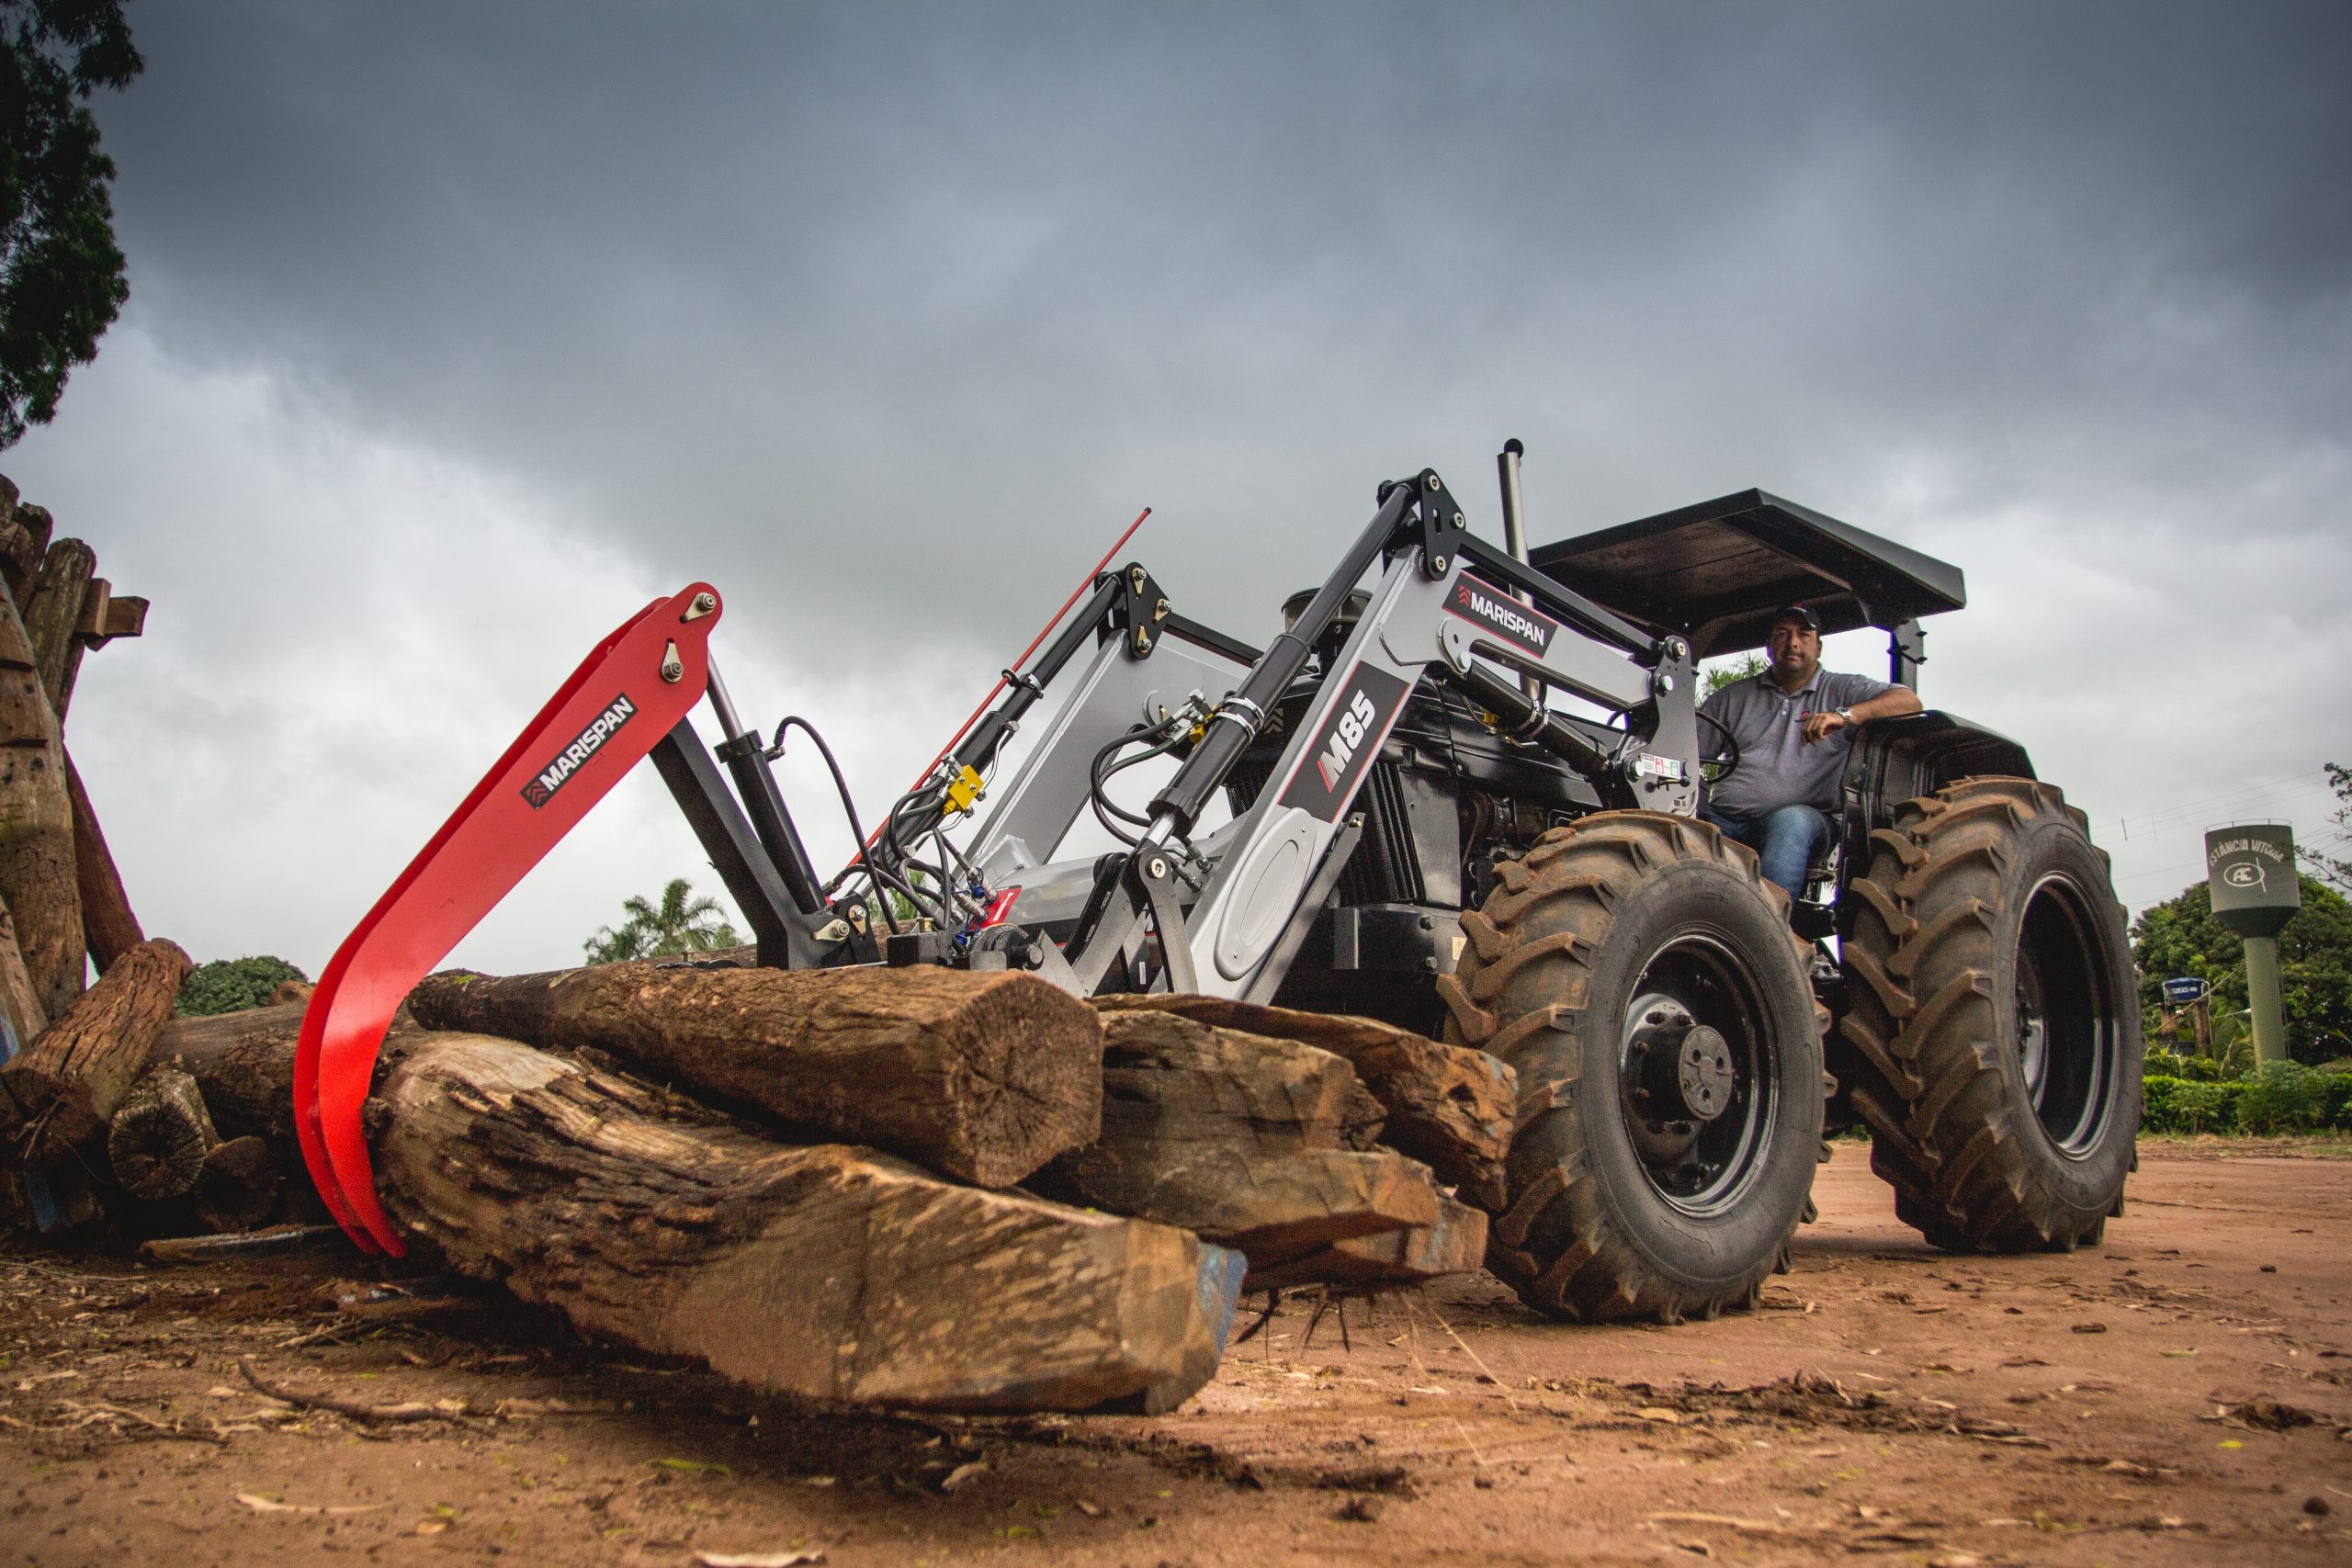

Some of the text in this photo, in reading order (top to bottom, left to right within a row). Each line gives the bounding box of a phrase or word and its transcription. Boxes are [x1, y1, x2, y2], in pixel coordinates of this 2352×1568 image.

[1471, 592, 1544, 647] MARISPAN
[539, 697, 634, 791] MARISPAN
[1317, 689, 1375, 793] M85
